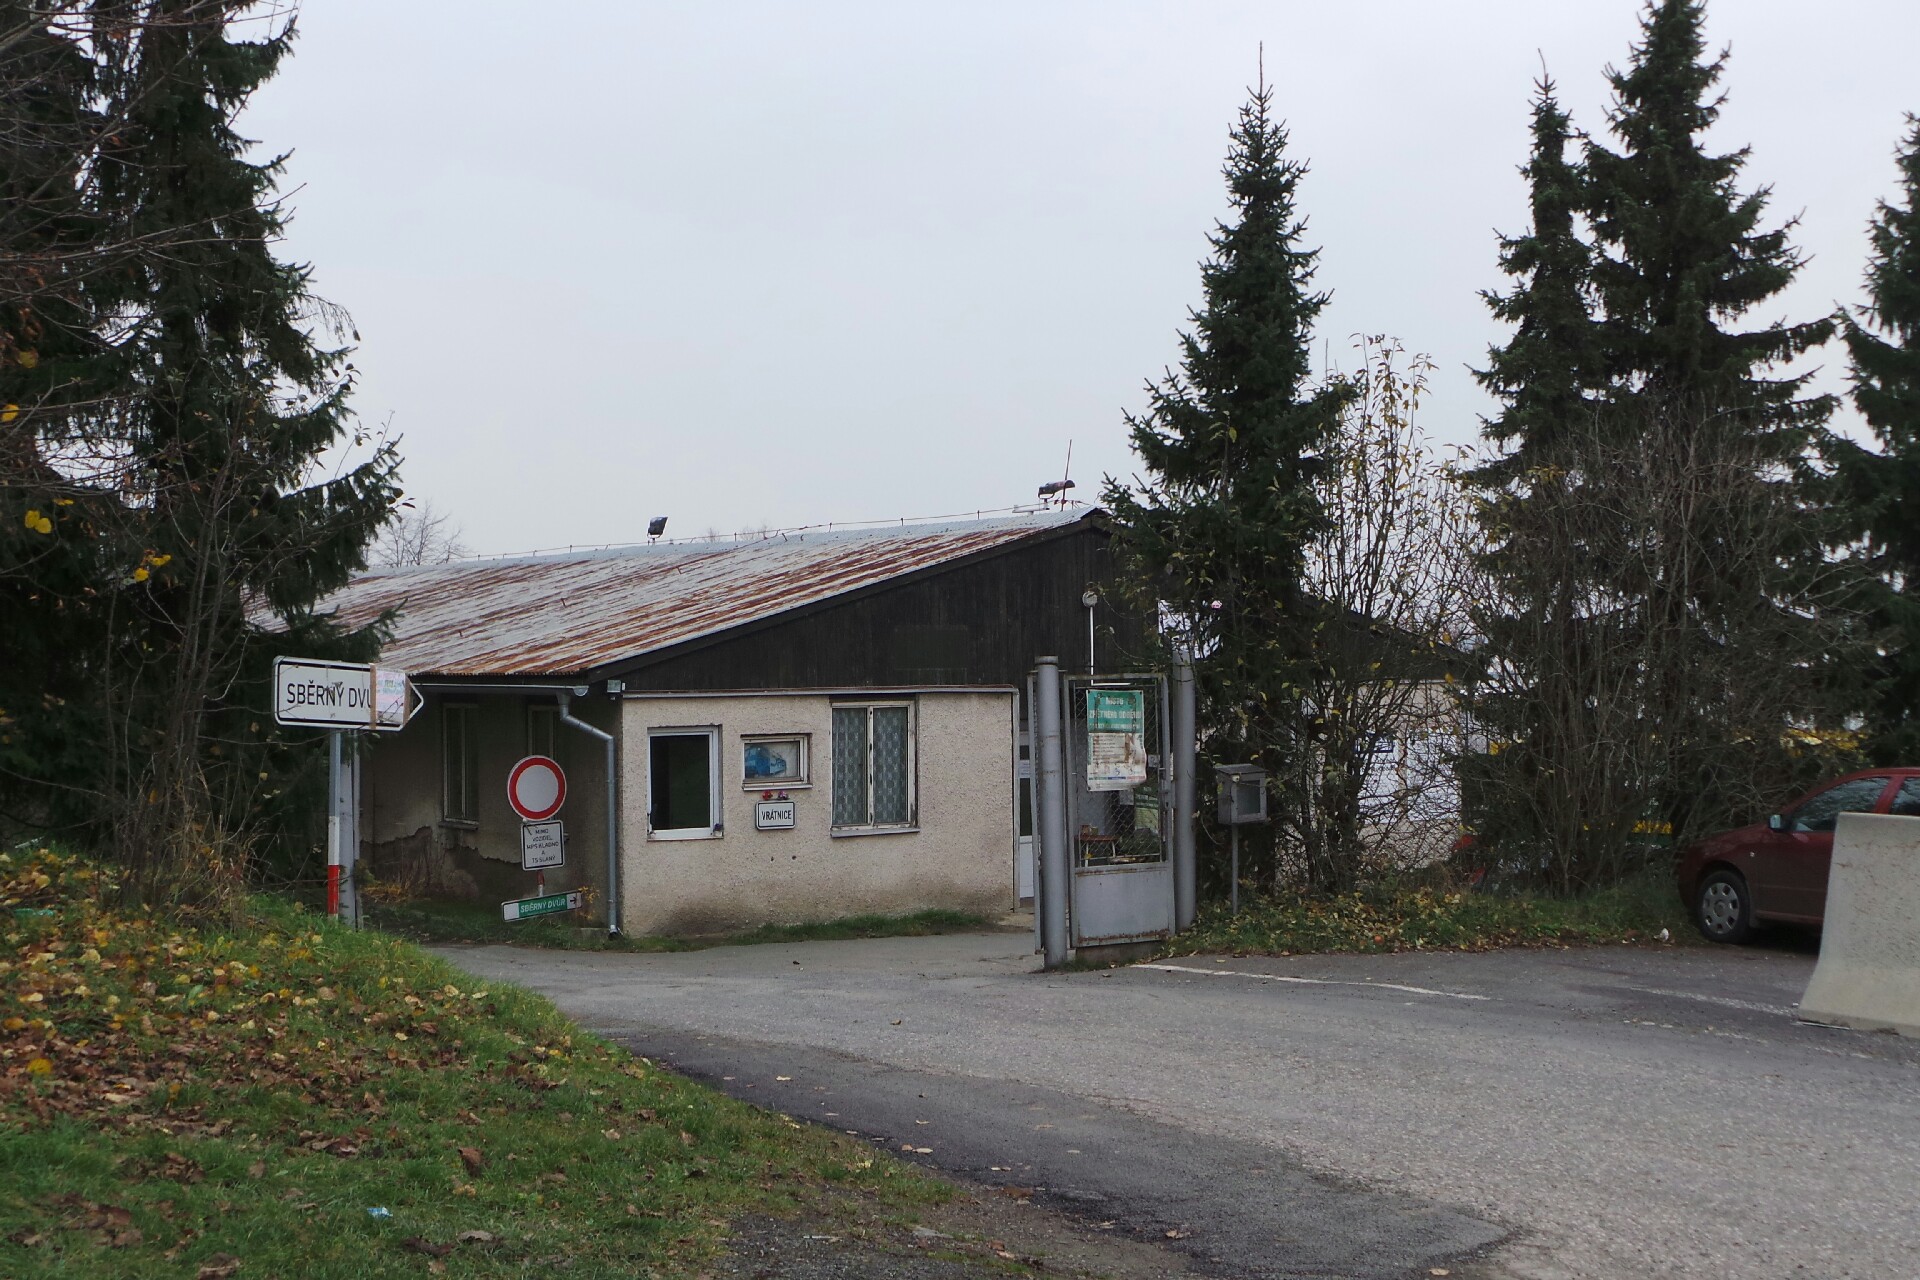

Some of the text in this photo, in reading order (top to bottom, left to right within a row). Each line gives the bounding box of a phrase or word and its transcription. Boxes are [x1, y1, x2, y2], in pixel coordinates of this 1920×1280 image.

[287, 680, 344, 706] SBĚRNÝ
[762, 809, 792, 820] VRÁTNICE
[520, 901, 547, 913] SBĚRNÝ
